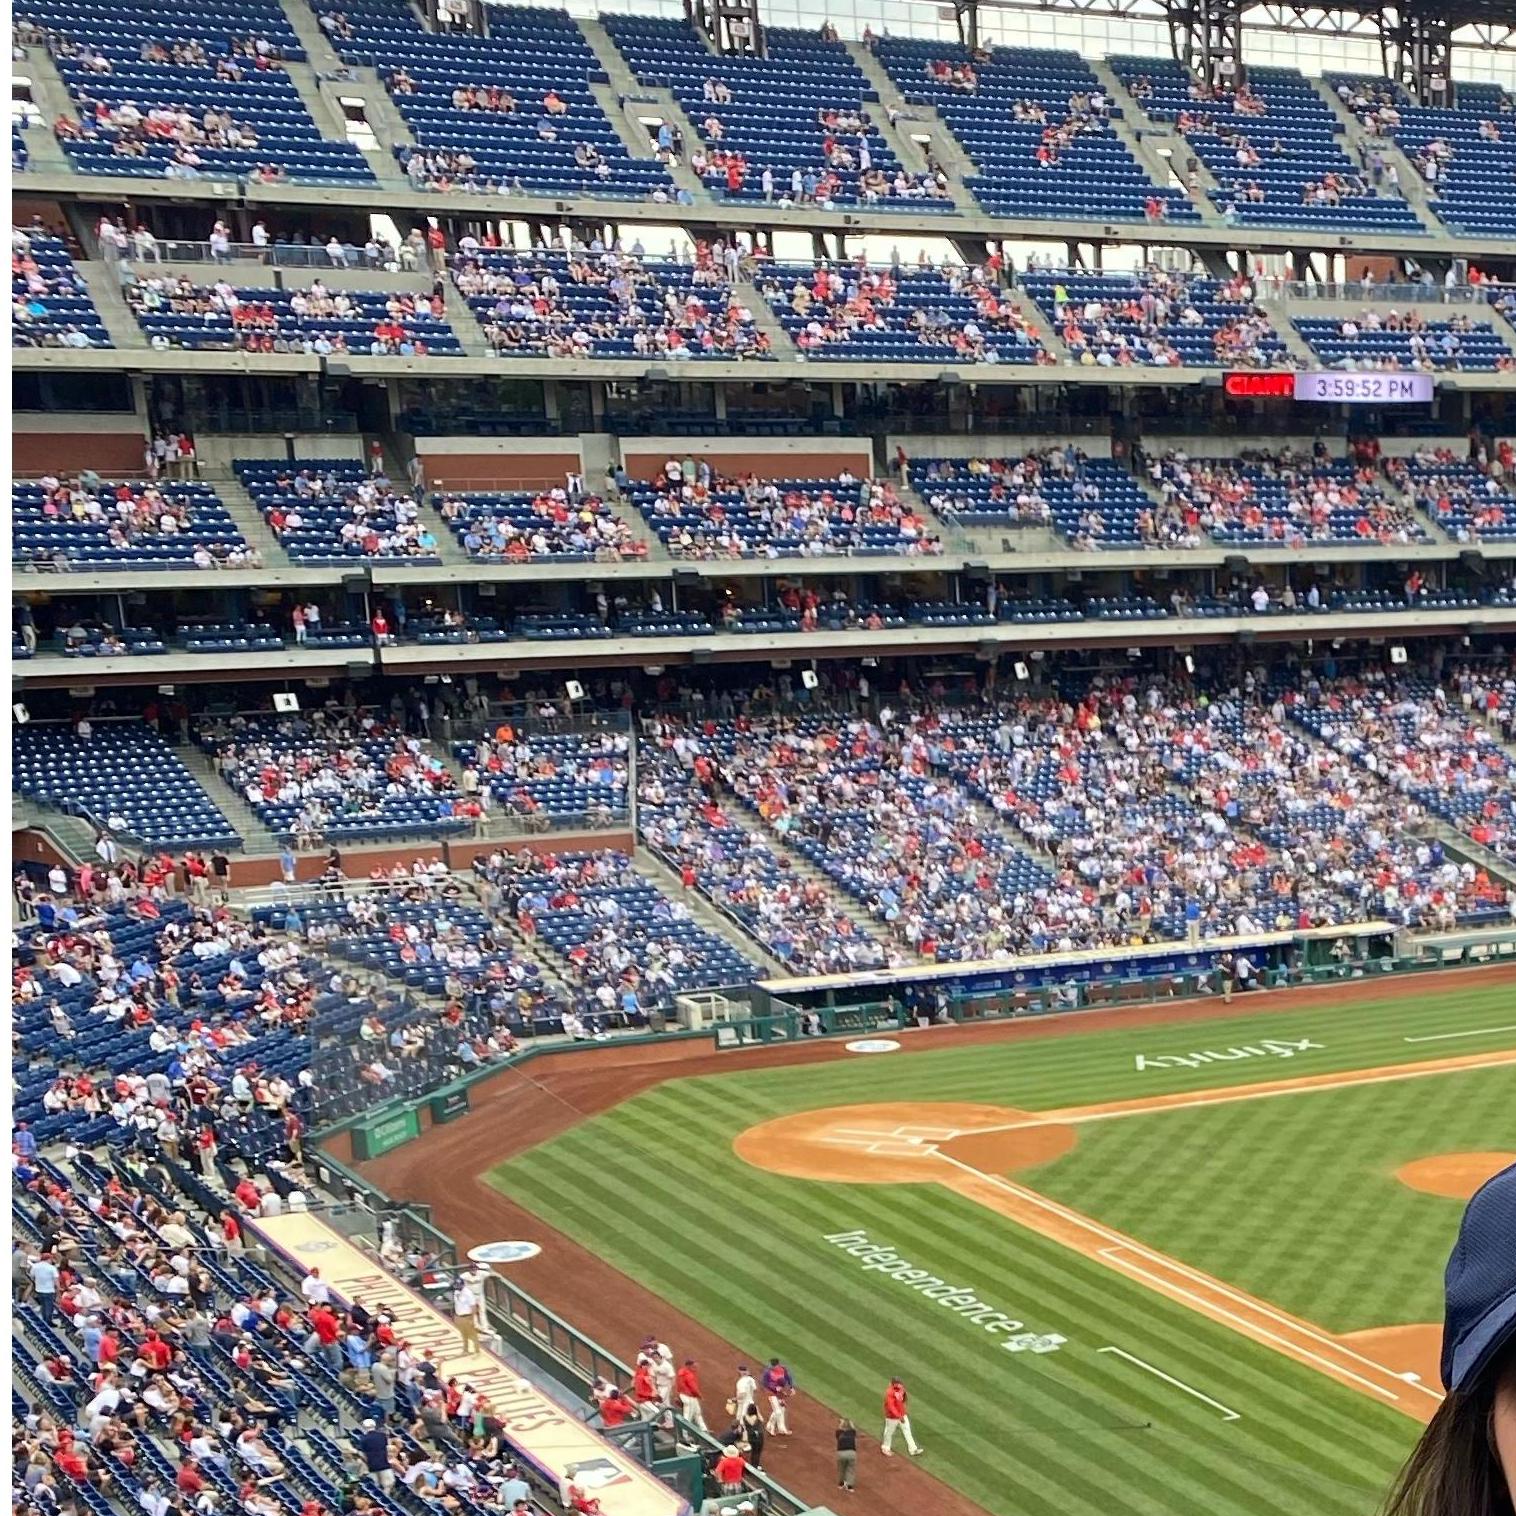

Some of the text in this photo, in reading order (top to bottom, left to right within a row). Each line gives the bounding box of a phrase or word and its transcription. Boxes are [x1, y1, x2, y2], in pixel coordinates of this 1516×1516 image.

[1317, 378, 1414, 398] 3:59:52 PM
[1135, 1038, 1327, 1072] xfinity
[823, 1229, 1024, 1334] Independence
